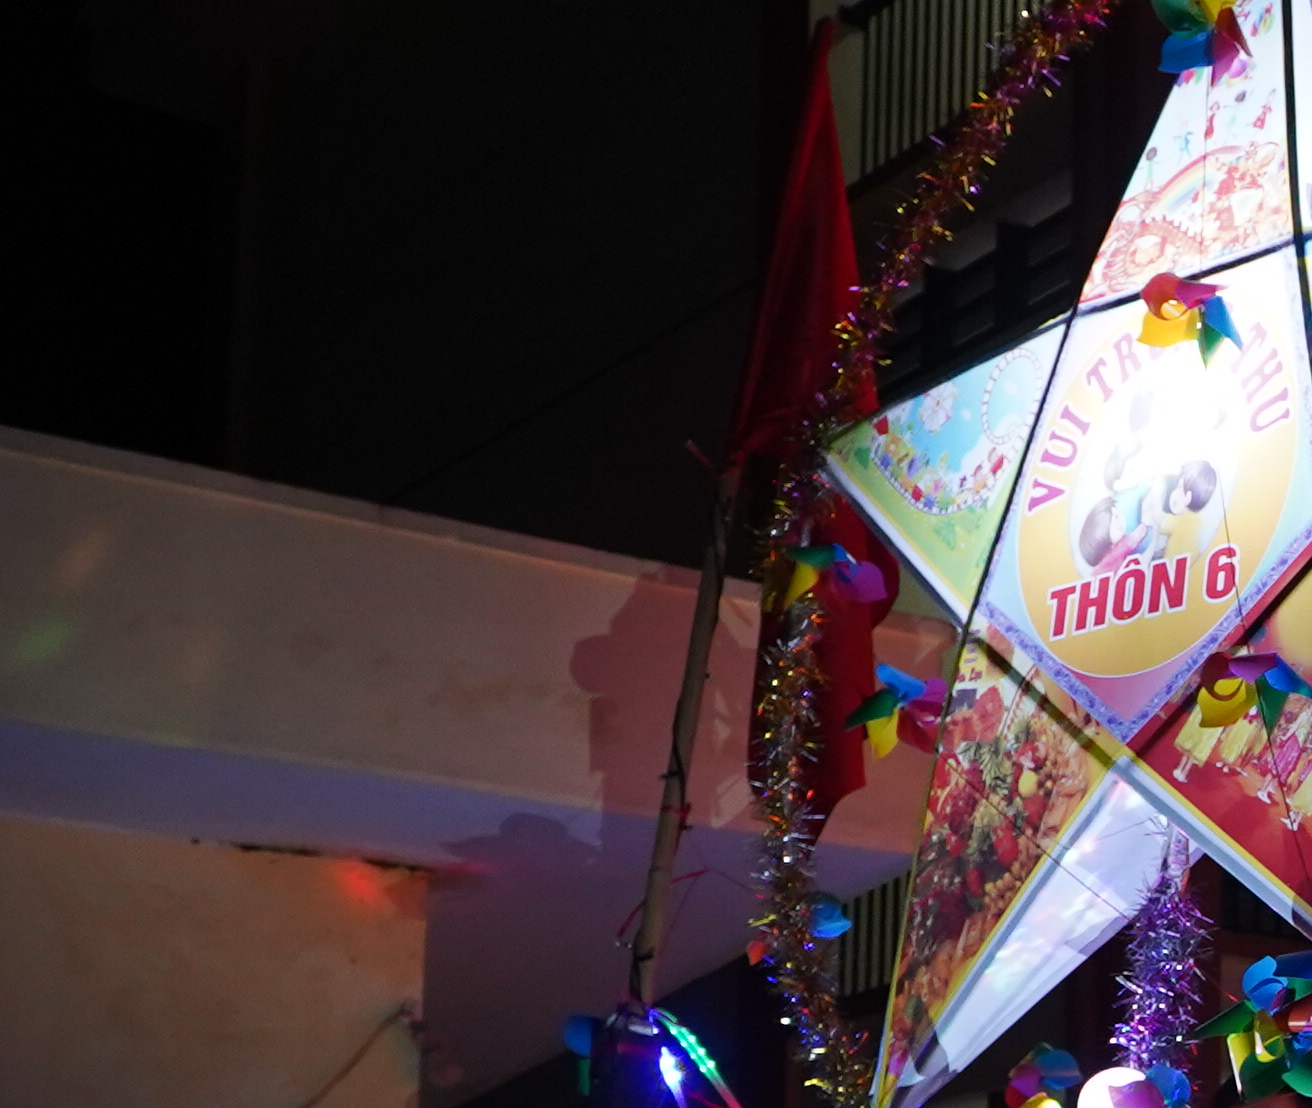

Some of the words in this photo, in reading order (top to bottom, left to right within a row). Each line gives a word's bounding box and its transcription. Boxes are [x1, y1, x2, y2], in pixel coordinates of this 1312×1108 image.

[1029, 404, 1091, 514] VUI
[1050, 552, 1188, 638] THÔN
[1205, 545, 1239, 599] 6
